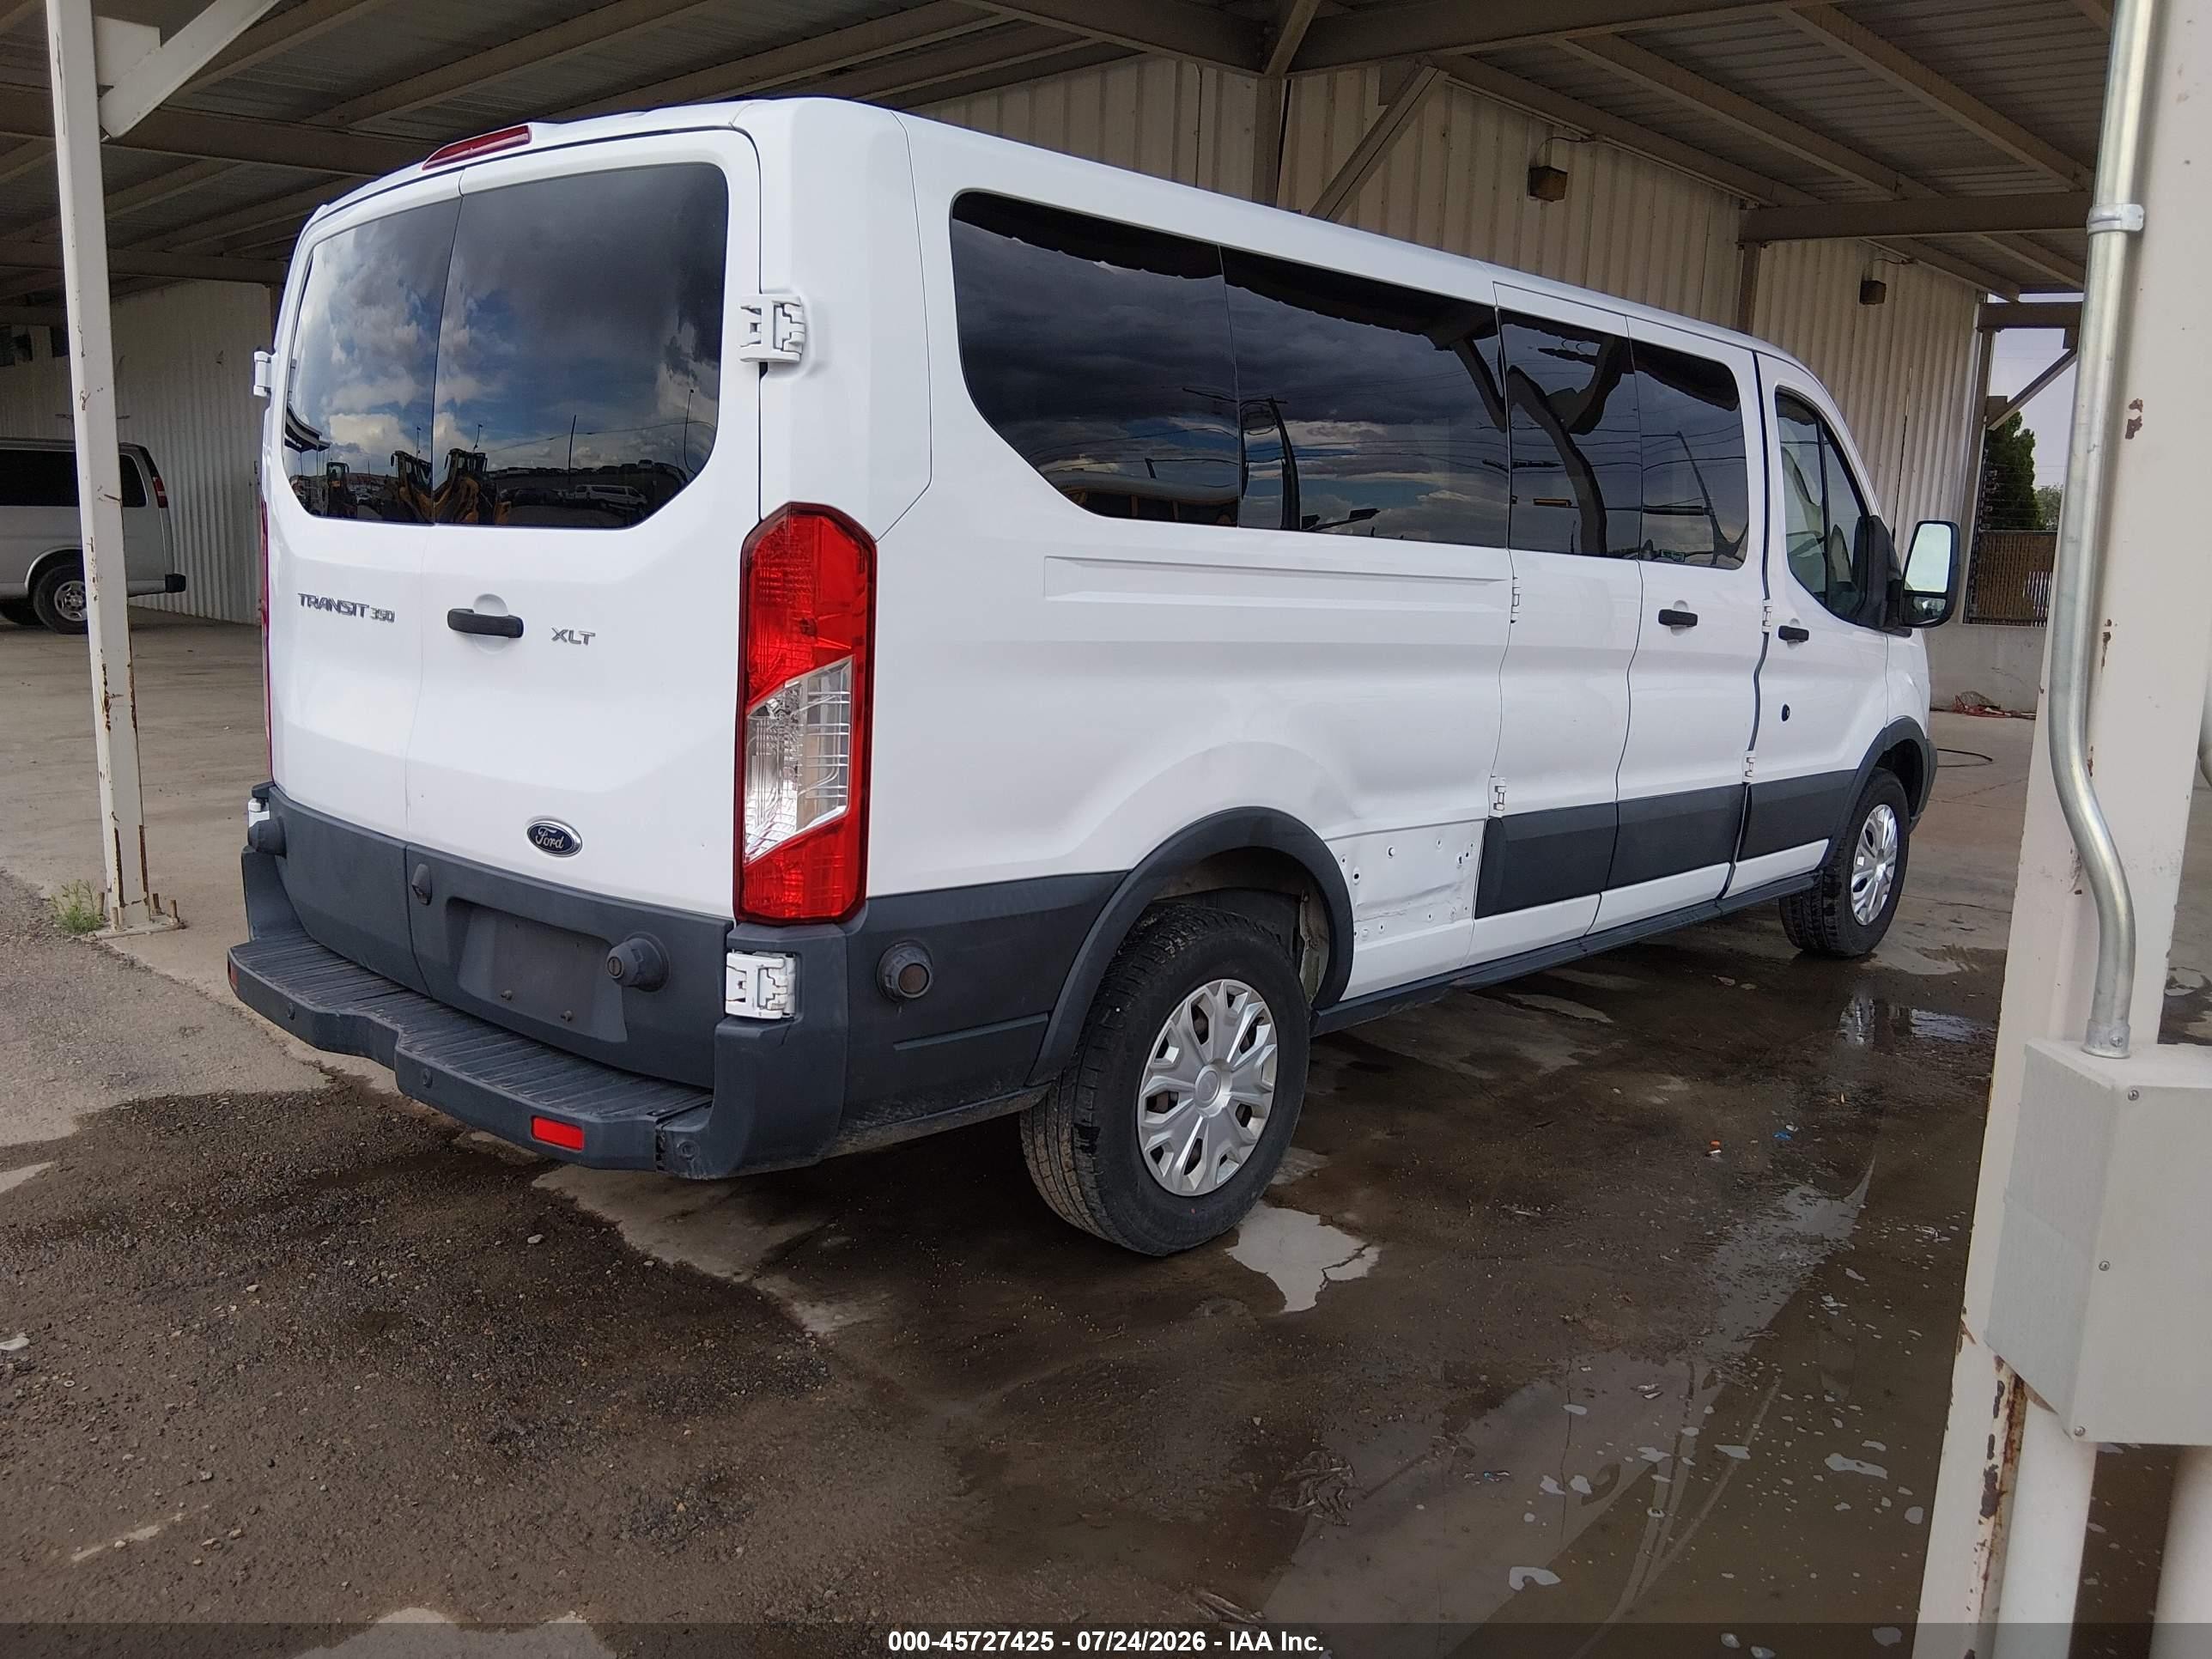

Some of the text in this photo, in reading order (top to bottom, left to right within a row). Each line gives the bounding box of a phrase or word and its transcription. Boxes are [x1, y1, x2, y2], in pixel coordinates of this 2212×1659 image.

[297, 593, 395, 623] TRANSIT 350
[551, 628, 595, 646] XLT
[535, 827, 564, 849] Ford
